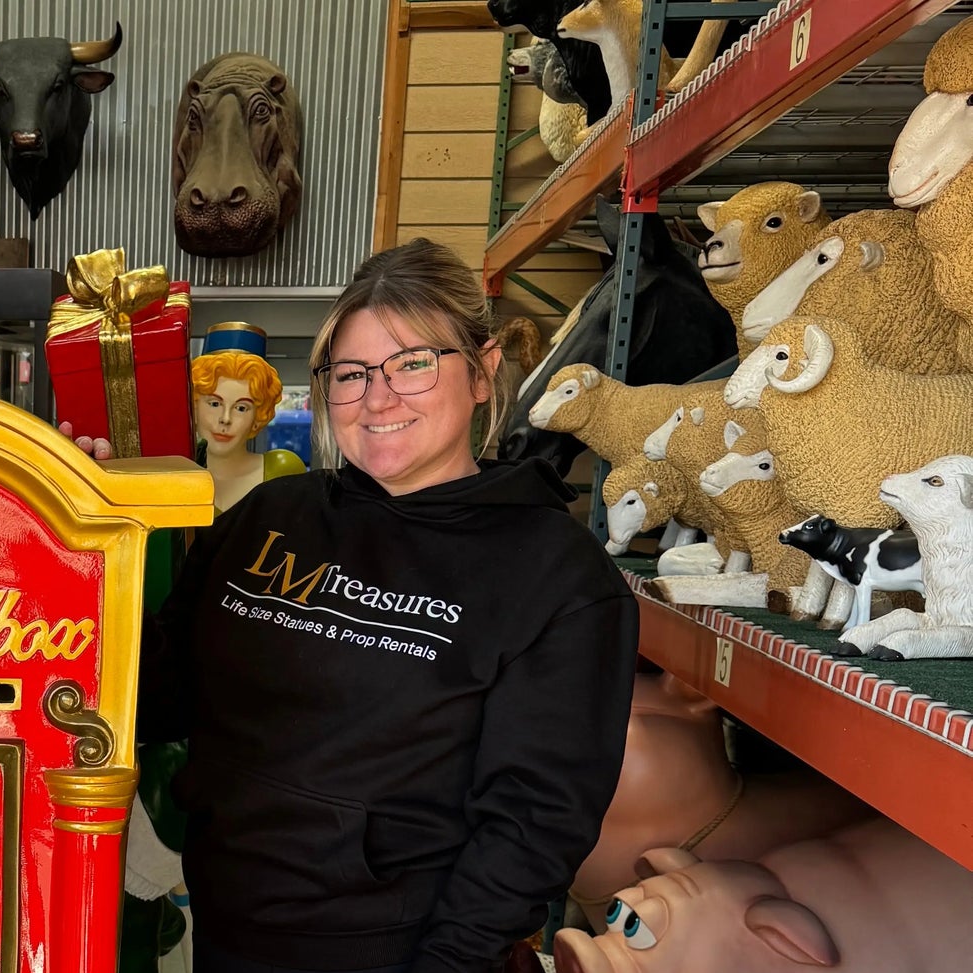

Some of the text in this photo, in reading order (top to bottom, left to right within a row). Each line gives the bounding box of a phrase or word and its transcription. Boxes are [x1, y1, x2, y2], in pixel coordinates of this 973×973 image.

[795, 16, 806, 64] 6
[220, 594, 439, 661] Life Size Statues & Prop Rentals
[719, 643, 730, 682] 5
